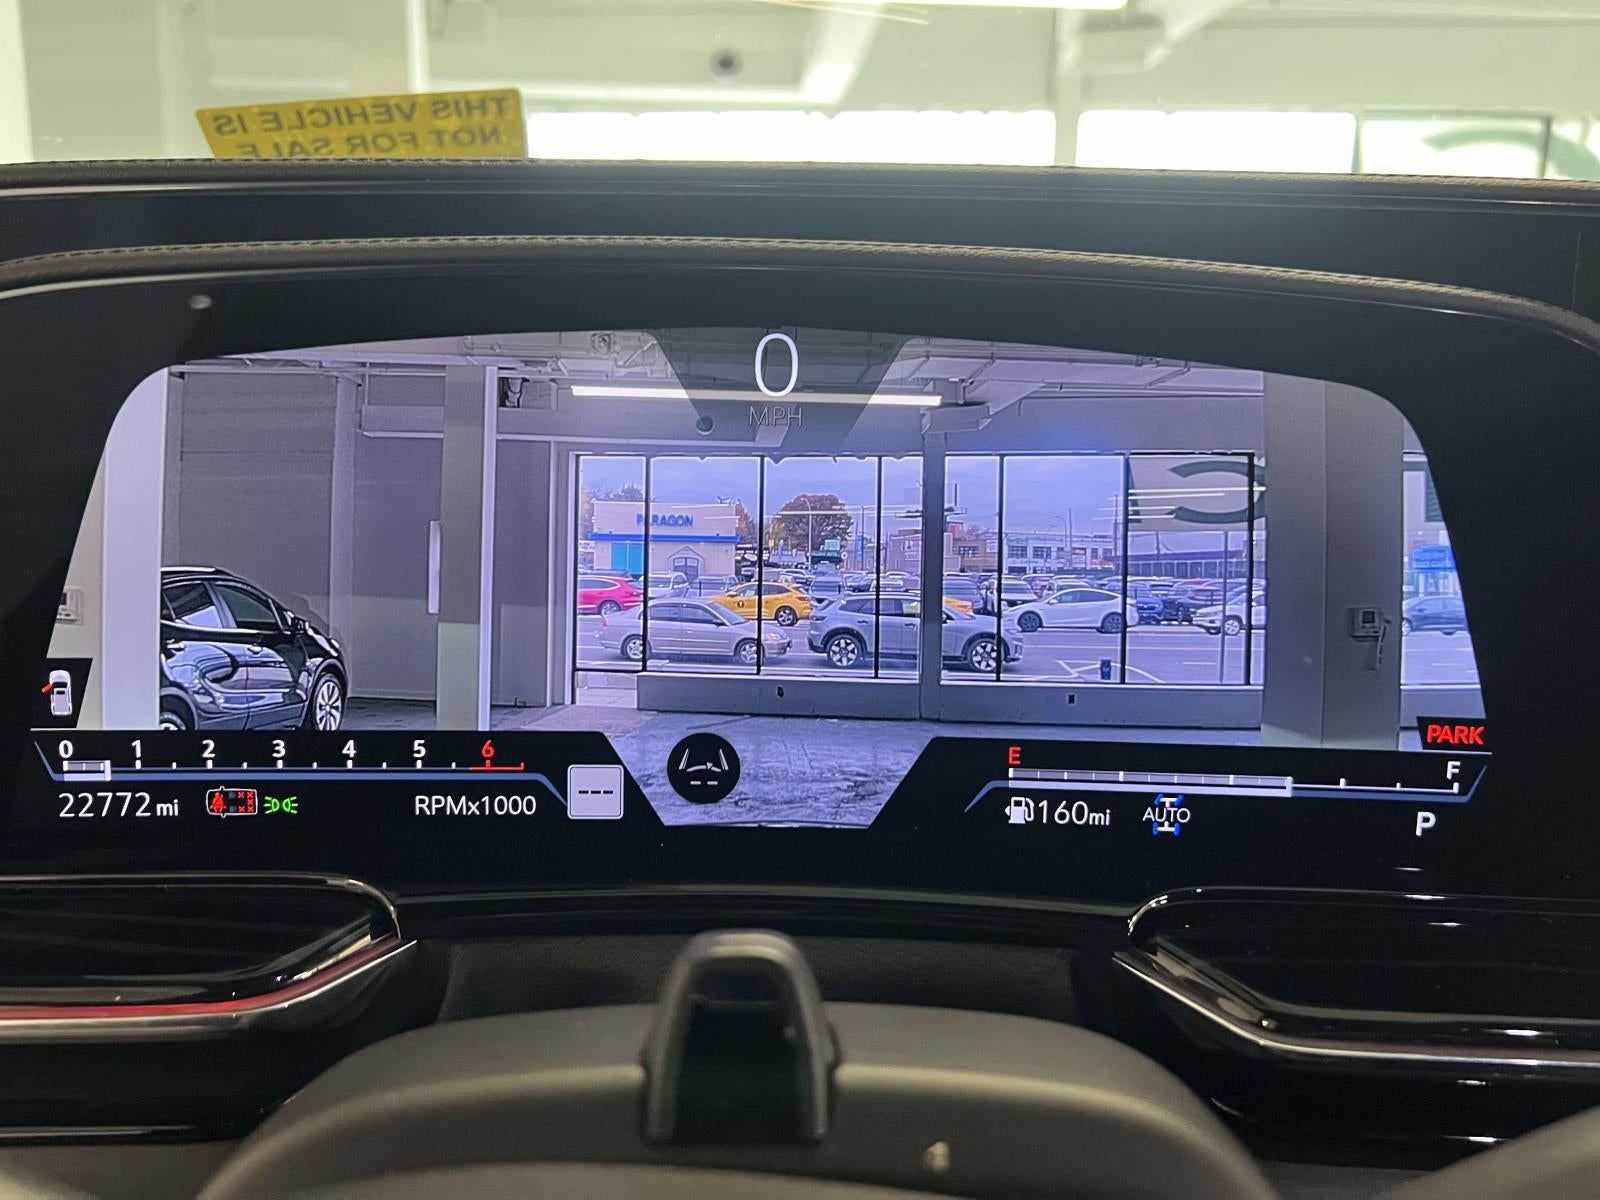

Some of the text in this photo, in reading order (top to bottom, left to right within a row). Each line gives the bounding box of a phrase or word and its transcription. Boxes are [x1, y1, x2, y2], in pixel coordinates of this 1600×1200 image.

[754, 332, 799, 397] 0
[749, 406, 803, 426] MPH
[636, 513, 694, 527] PRAGON
[1426, 724, 1486, 745] PARK
[58, 739, 495, 759] 0 1 2 3 4 5 6
[1008, 746, 1022, 765] E
[1446, 761, 1461, 780] F
[58, 792, 179, 817] 22772 mi
[414, 795, 537, 816] RPMx1000
[1142, 807, 1191, 823] AUTO
[1415, 811, 1437, 837] P
